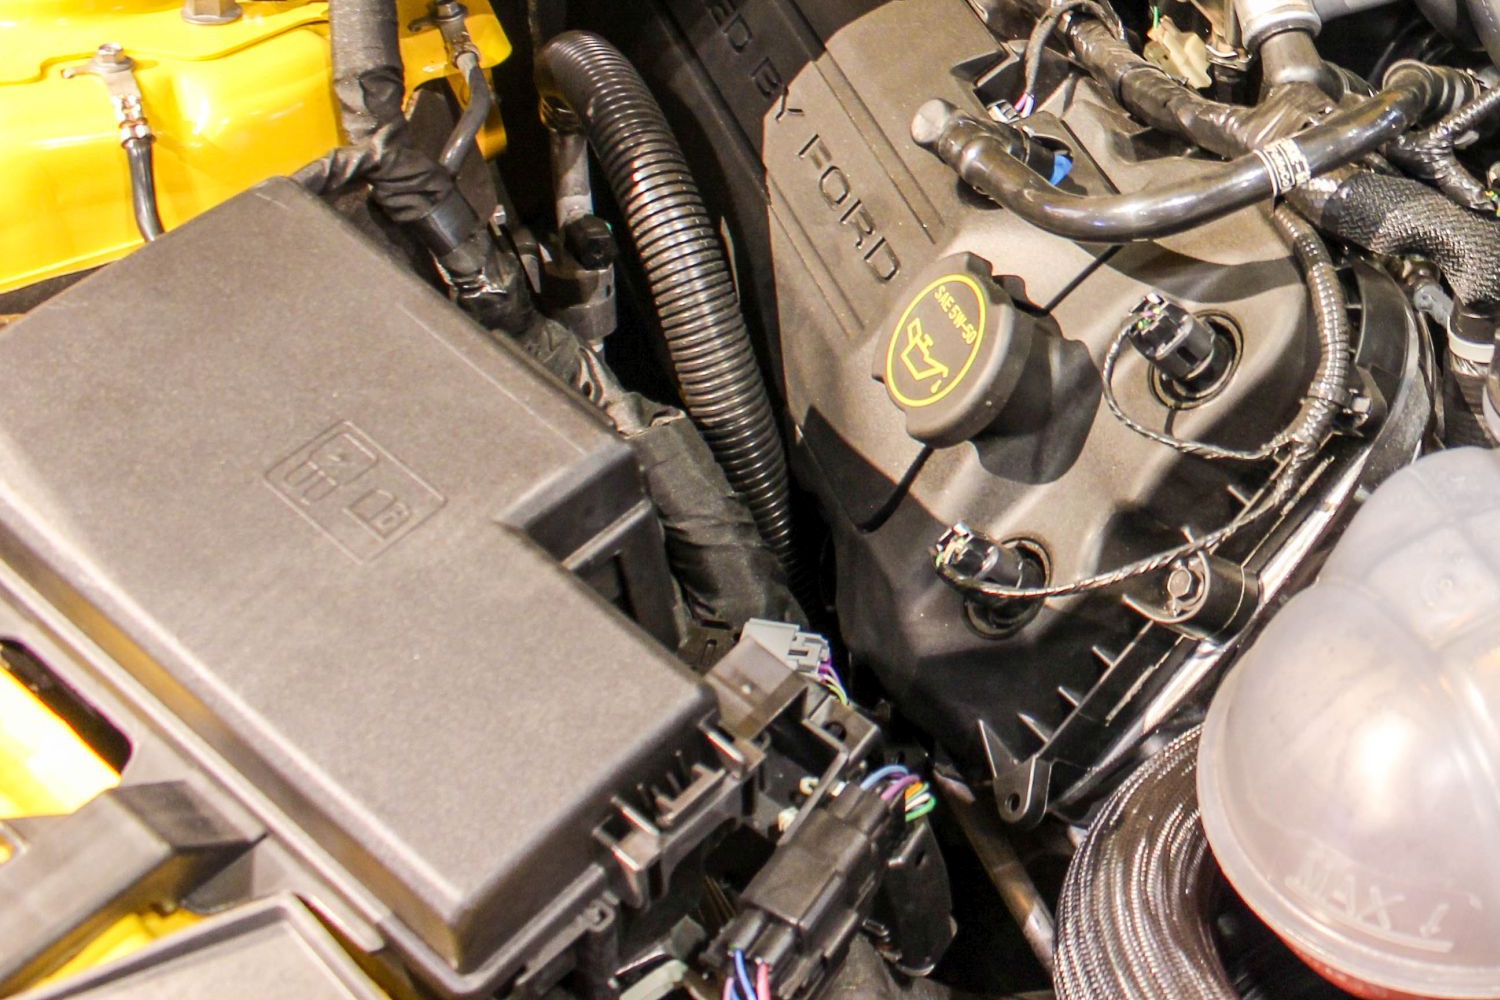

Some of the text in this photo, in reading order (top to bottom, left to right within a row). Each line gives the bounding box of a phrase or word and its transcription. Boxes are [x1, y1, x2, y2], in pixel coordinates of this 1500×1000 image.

[751, 56, 804, 124] BY
[798, 133, 900, 283] FORD
[934, 285, 955, 313] SAE
